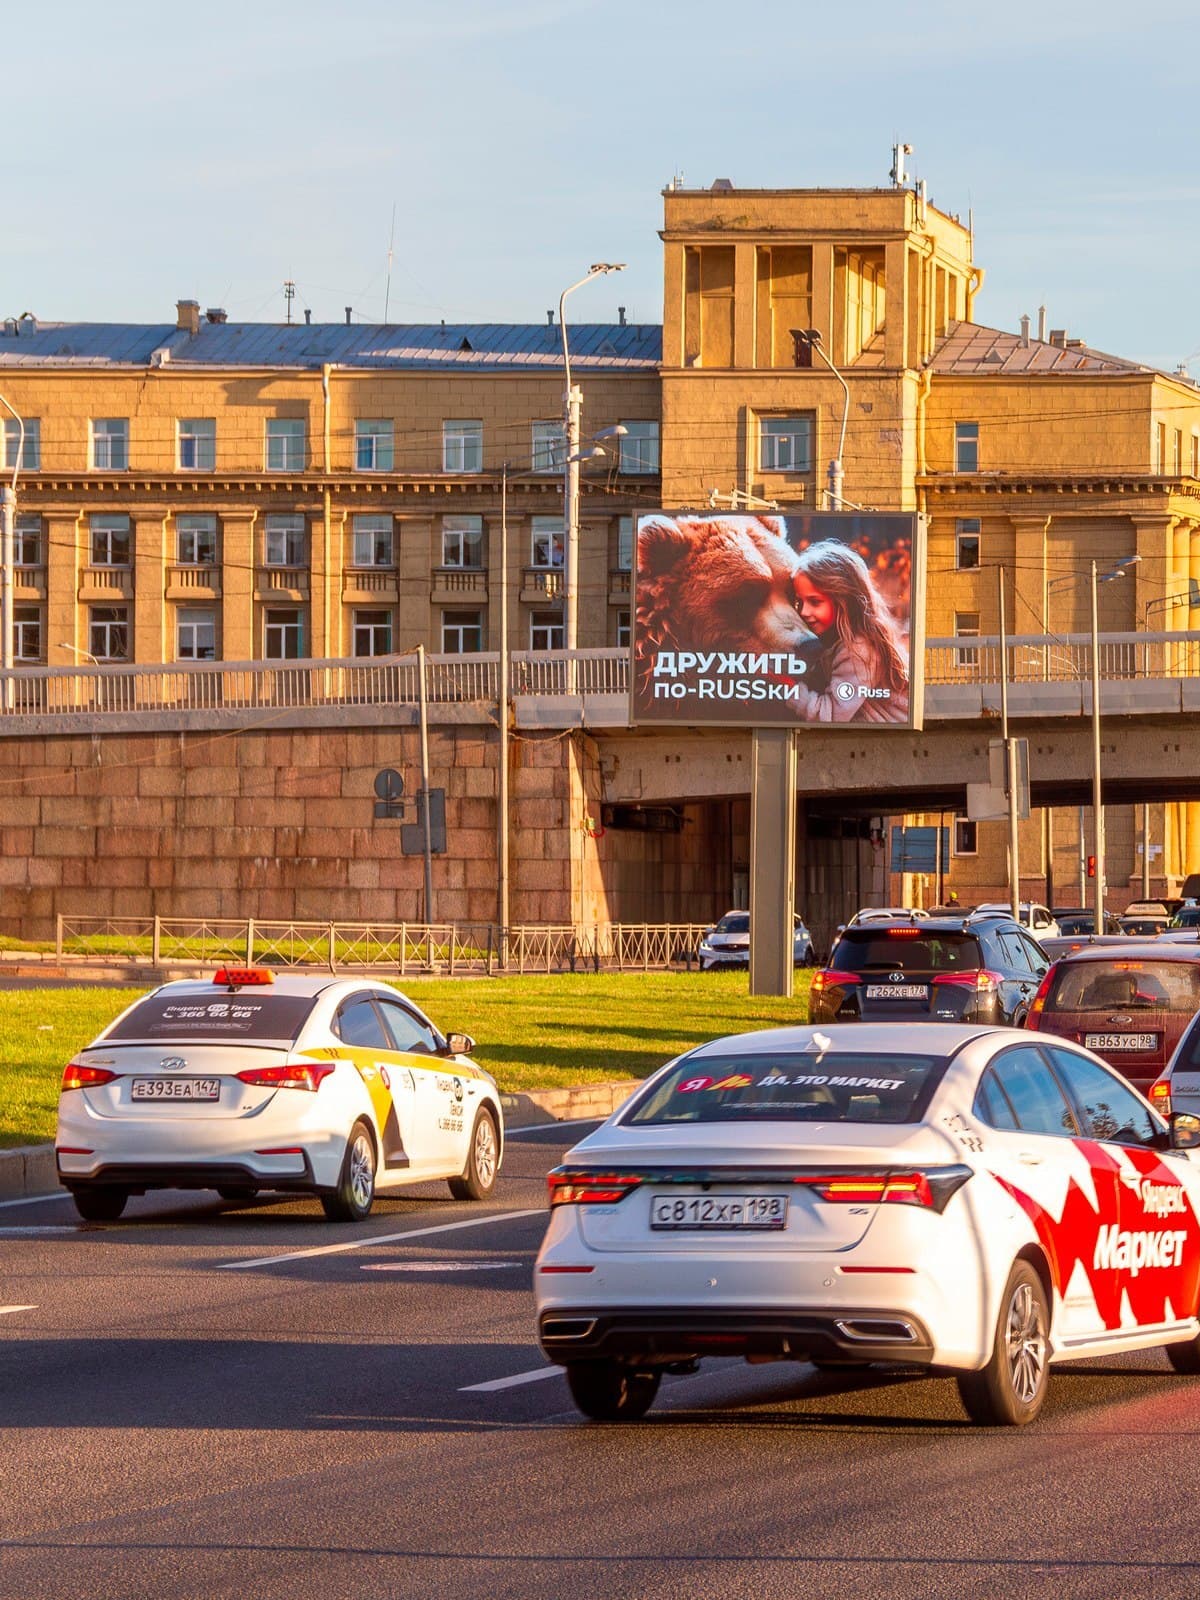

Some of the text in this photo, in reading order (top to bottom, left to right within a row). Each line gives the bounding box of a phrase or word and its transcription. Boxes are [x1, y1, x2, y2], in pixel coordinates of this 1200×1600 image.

[653, 652, 808, 678] ДРУЖИТЬ
[654, 679, 800, 700] по-RUSSки
[858, 687, 890, 698] Russ
[1090, 1035, 1137, 1047] Е863УС
[137, 1081, 215, 1096] Е393ЕА 147
[756, 1075, 905, 1090] ДА, ЭТО МАРКЕТ
[1141, 1179, 1188, 1219] Яндекс
[658, 1199, 780, 1221] С812ХР 198
[1093, 1223, 1188, 1278] Маркет
